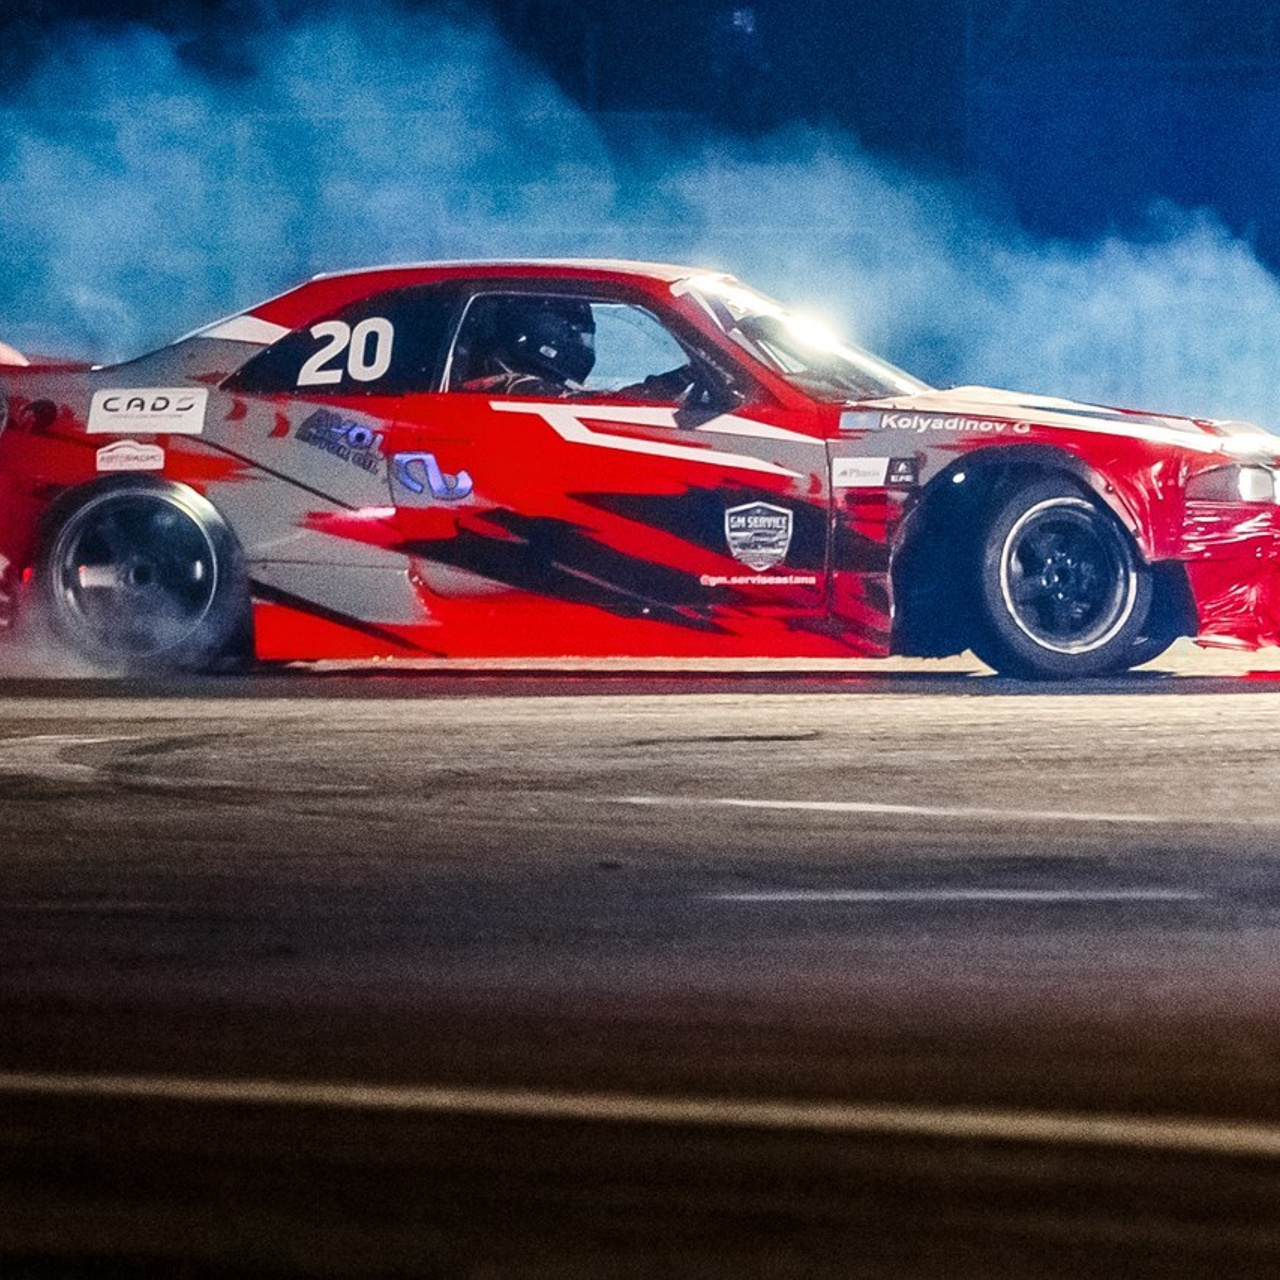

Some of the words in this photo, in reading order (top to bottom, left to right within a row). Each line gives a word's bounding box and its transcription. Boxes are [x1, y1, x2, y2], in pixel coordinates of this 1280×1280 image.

[297, 318, 393, 385] 20
[881, 414, 1007, 433] Kolyadinov
[1013, 422, 1031, 434] G
[747, 516, 787, 529] SERVICE
